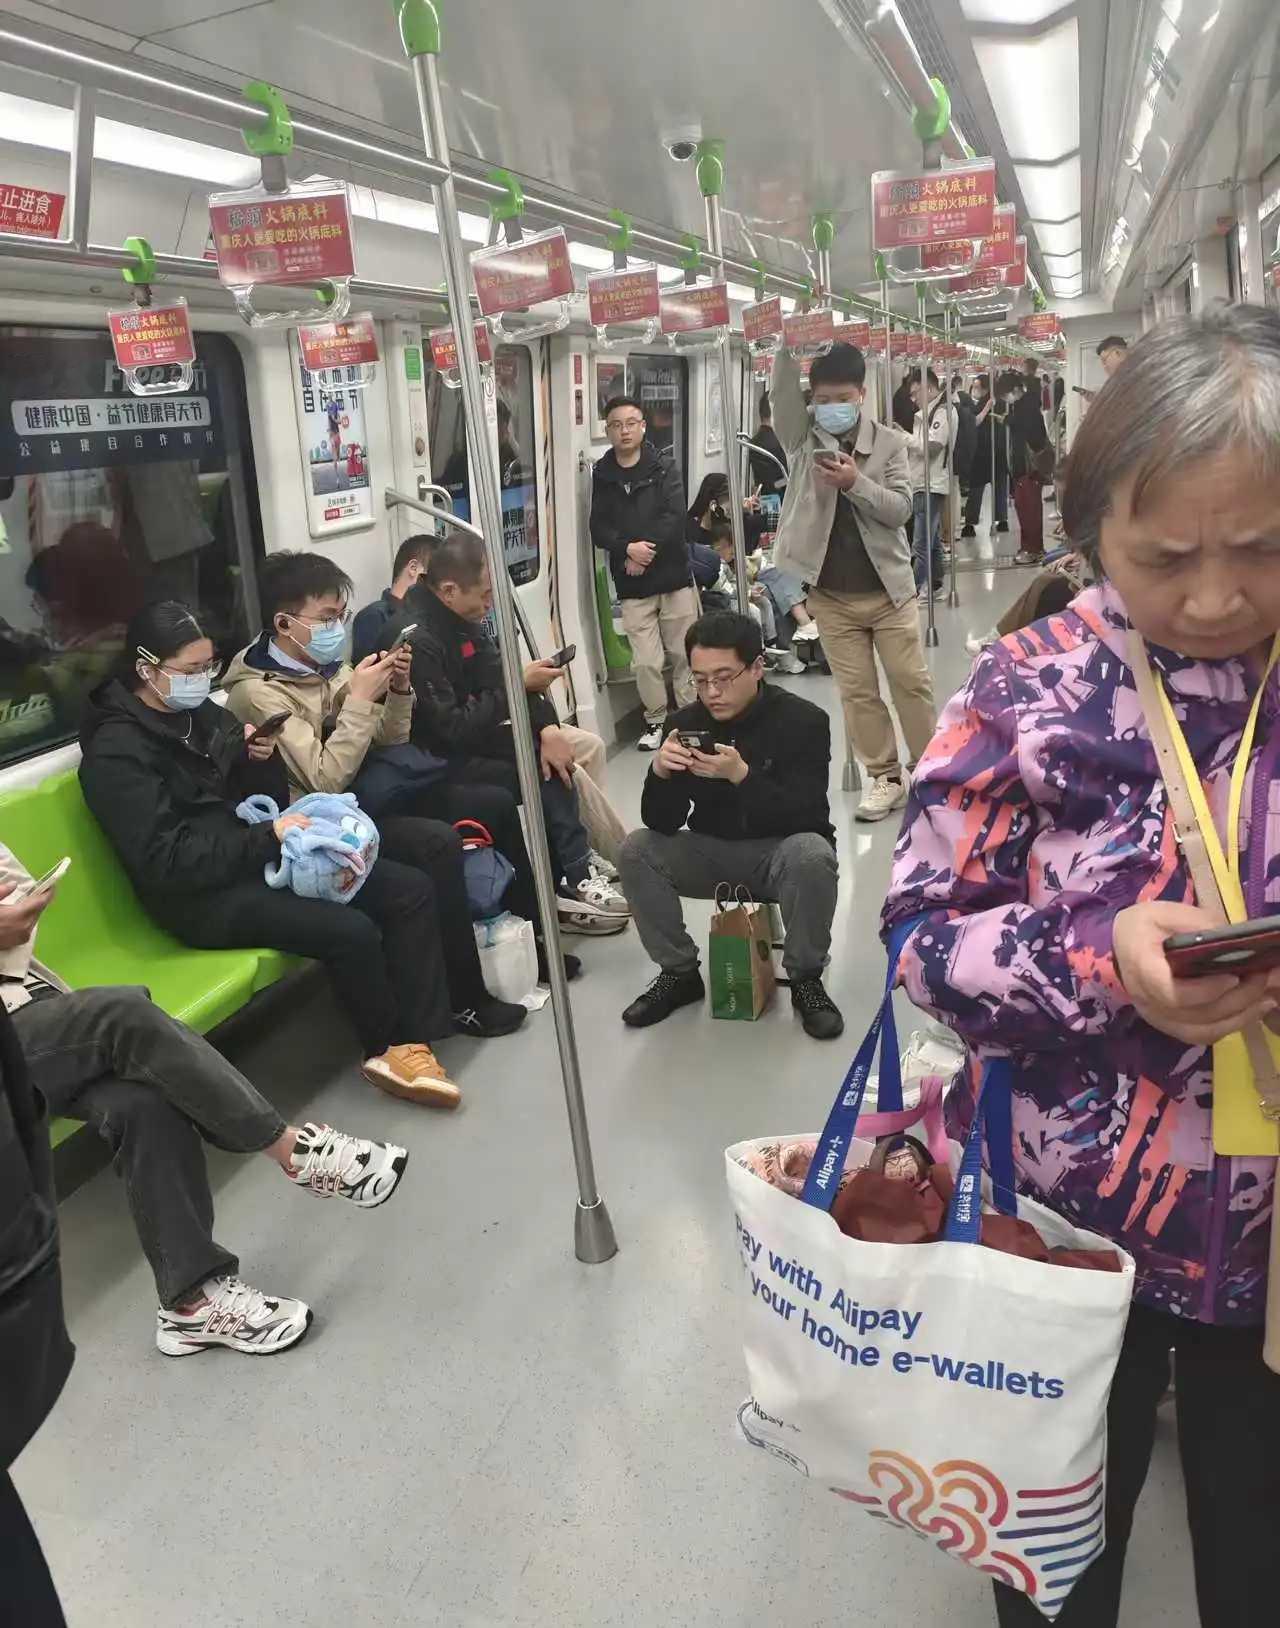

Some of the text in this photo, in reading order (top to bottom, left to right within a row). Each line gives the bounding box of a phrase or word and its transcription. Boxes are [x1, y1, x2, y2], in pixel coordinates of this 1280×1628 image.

[0, 188, 51, 215] 止进食
[750, 1271, 1065, 1399] your home e-wallets
[768, 1248, 822, 1301] with
[830, 1288, 923, 1340] Alipay
